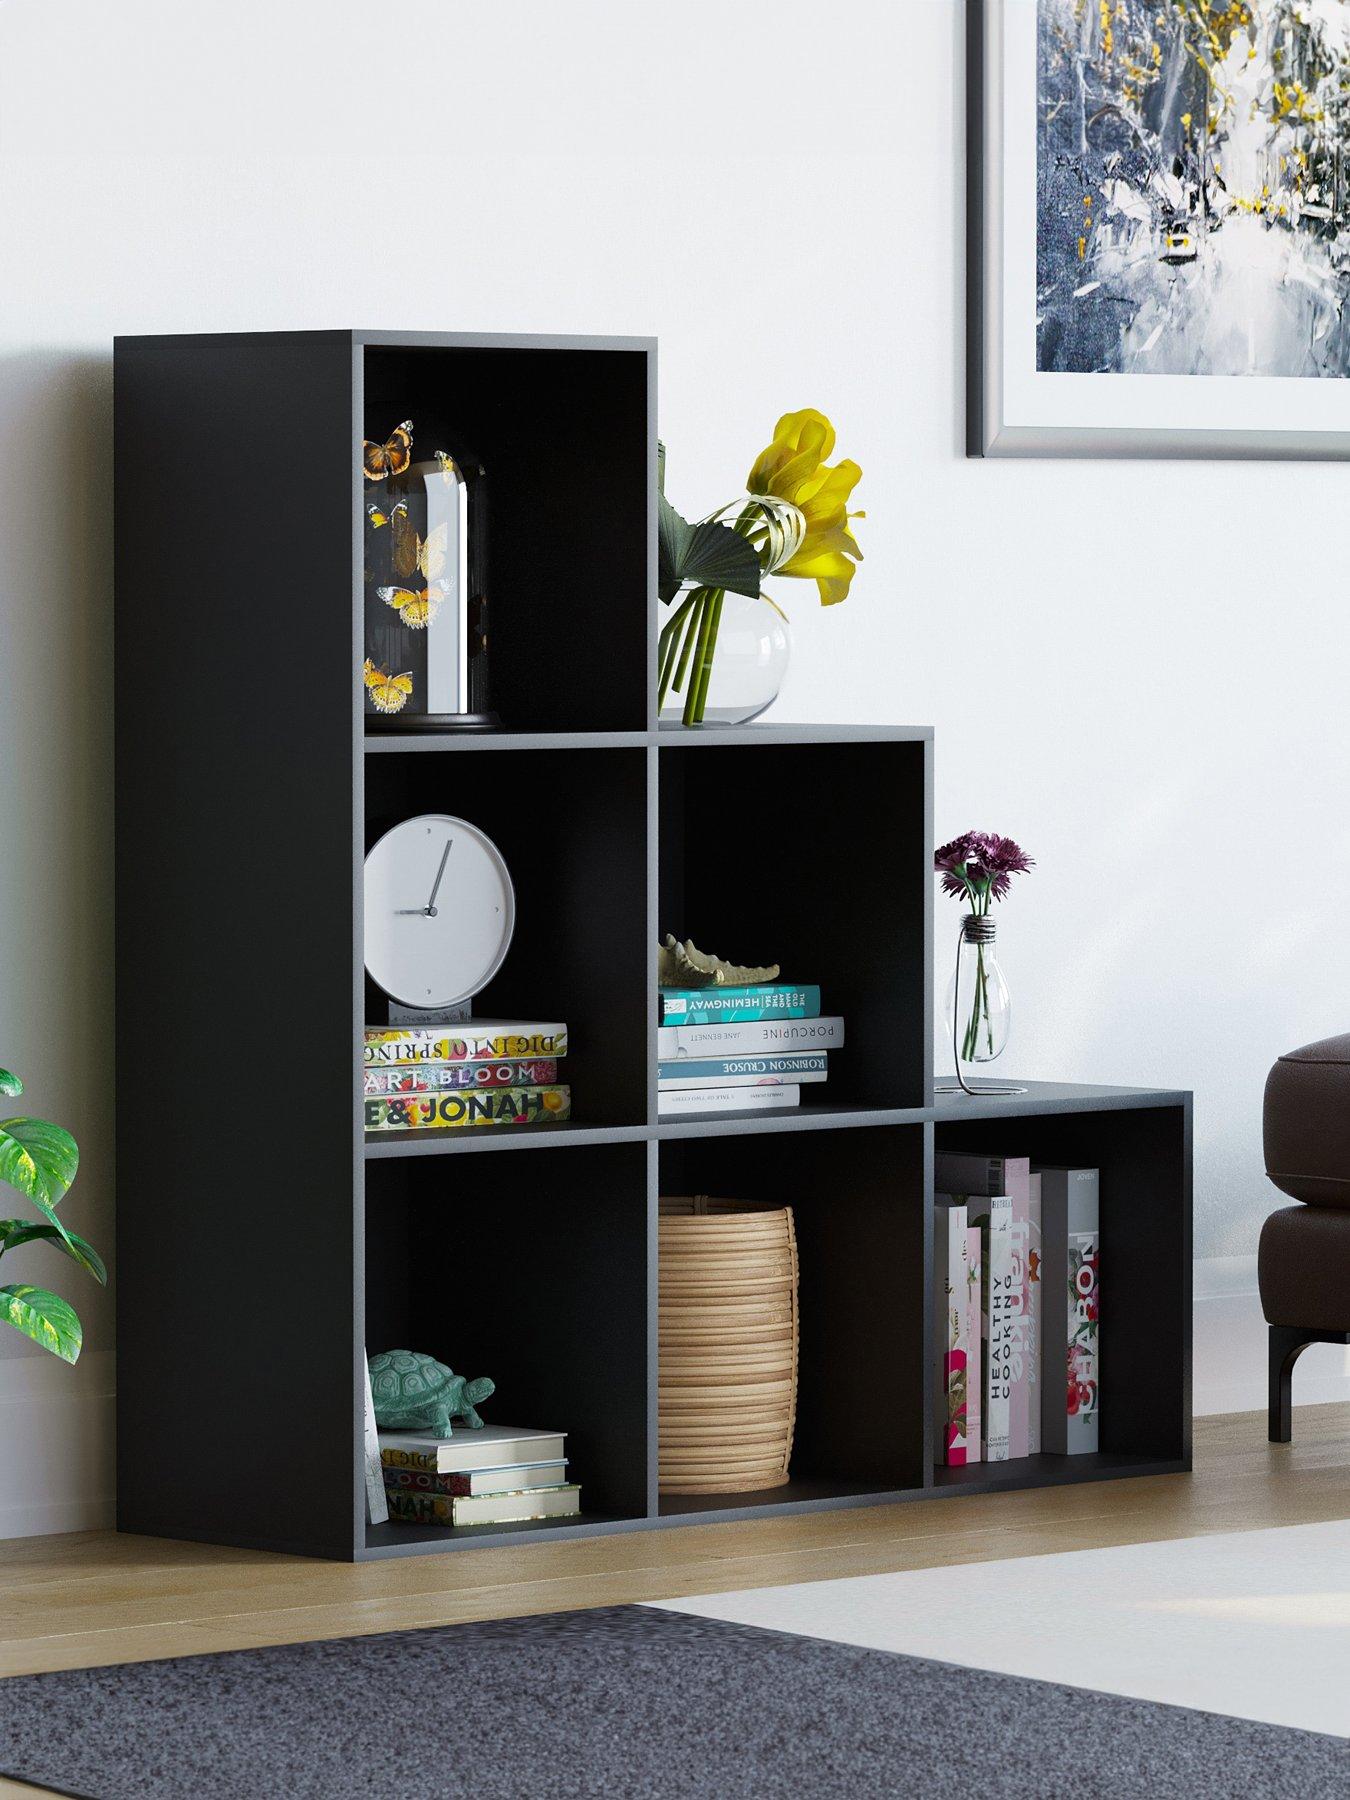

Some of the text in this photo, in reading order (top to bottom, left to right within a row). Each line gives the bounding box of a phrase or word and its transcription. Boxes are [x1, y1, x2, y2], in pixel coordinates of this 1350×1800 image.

[689, 997, 759, 1011] HEMINGWAY
[690, 1031, 741, 1042] JANE BENNETT
[762, 1025, 834, 1040] PORCUPINE
[364, 1035, 555, 1062] DIG INTO SPRING
[365, 1064, 536, 1091] ART BLOOM
[723, 1058, 825, 1073] ROBINSON CRUSOE
[386, 1099, 410, 1125] &
[422, 1093, 544, 1123] JONAH
[1076, 1235, 1095, 1412] CHABON
[992, 1278, 1002, 1399] HEALTHY
[1002, 1275, 1012, 1400] COOKING
